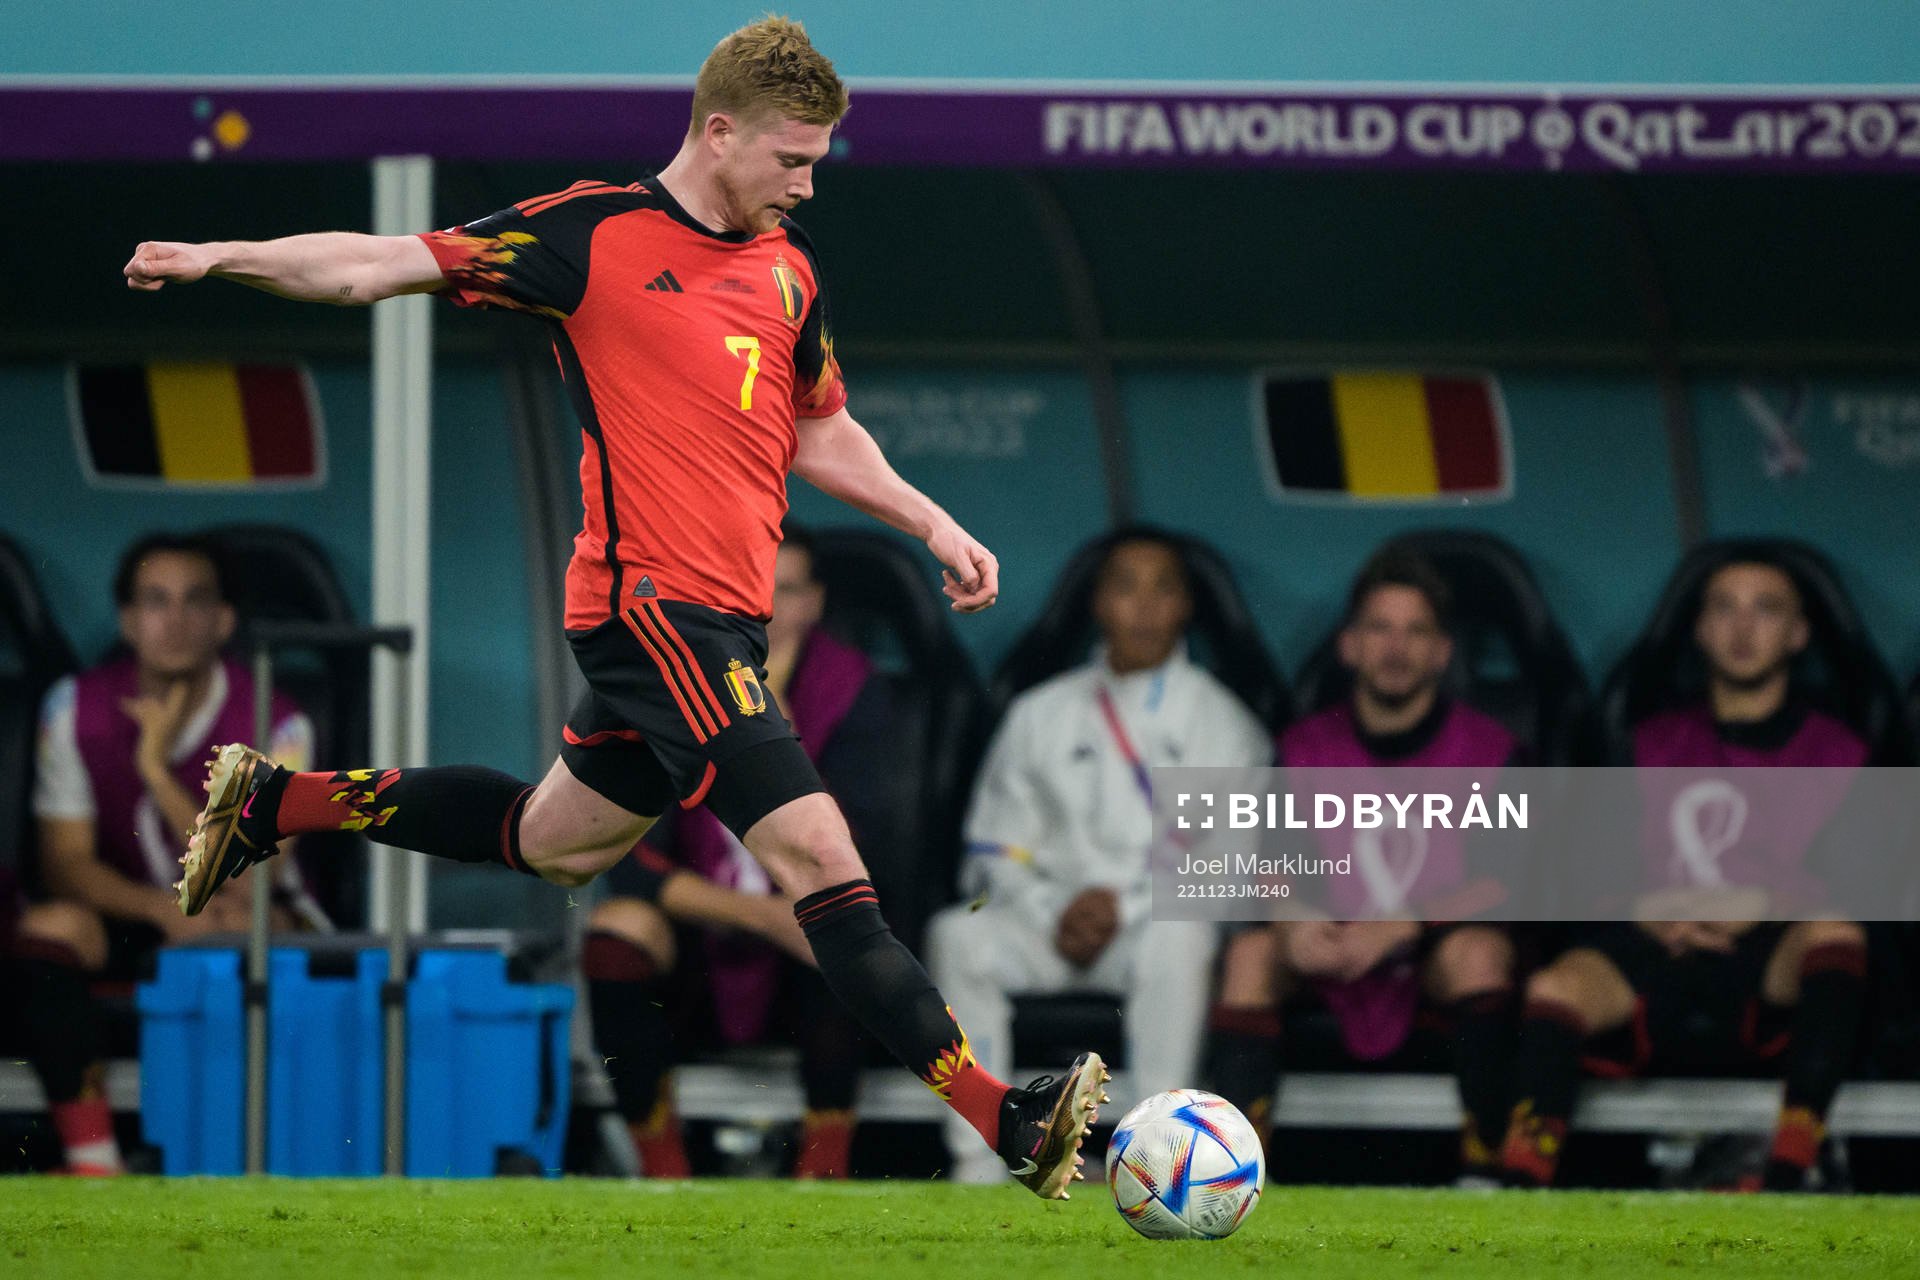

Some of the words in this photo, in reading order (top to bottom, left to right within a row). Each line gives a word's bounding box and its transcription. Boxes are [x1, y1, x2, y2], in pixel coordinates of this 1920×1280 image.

[1046, 104, 1174, 154] FIFA
[1178, 104, 1397, 155] WORLD
[1404, 104, 1525, 156] CUP
[724, 336, 762, 410] 7
